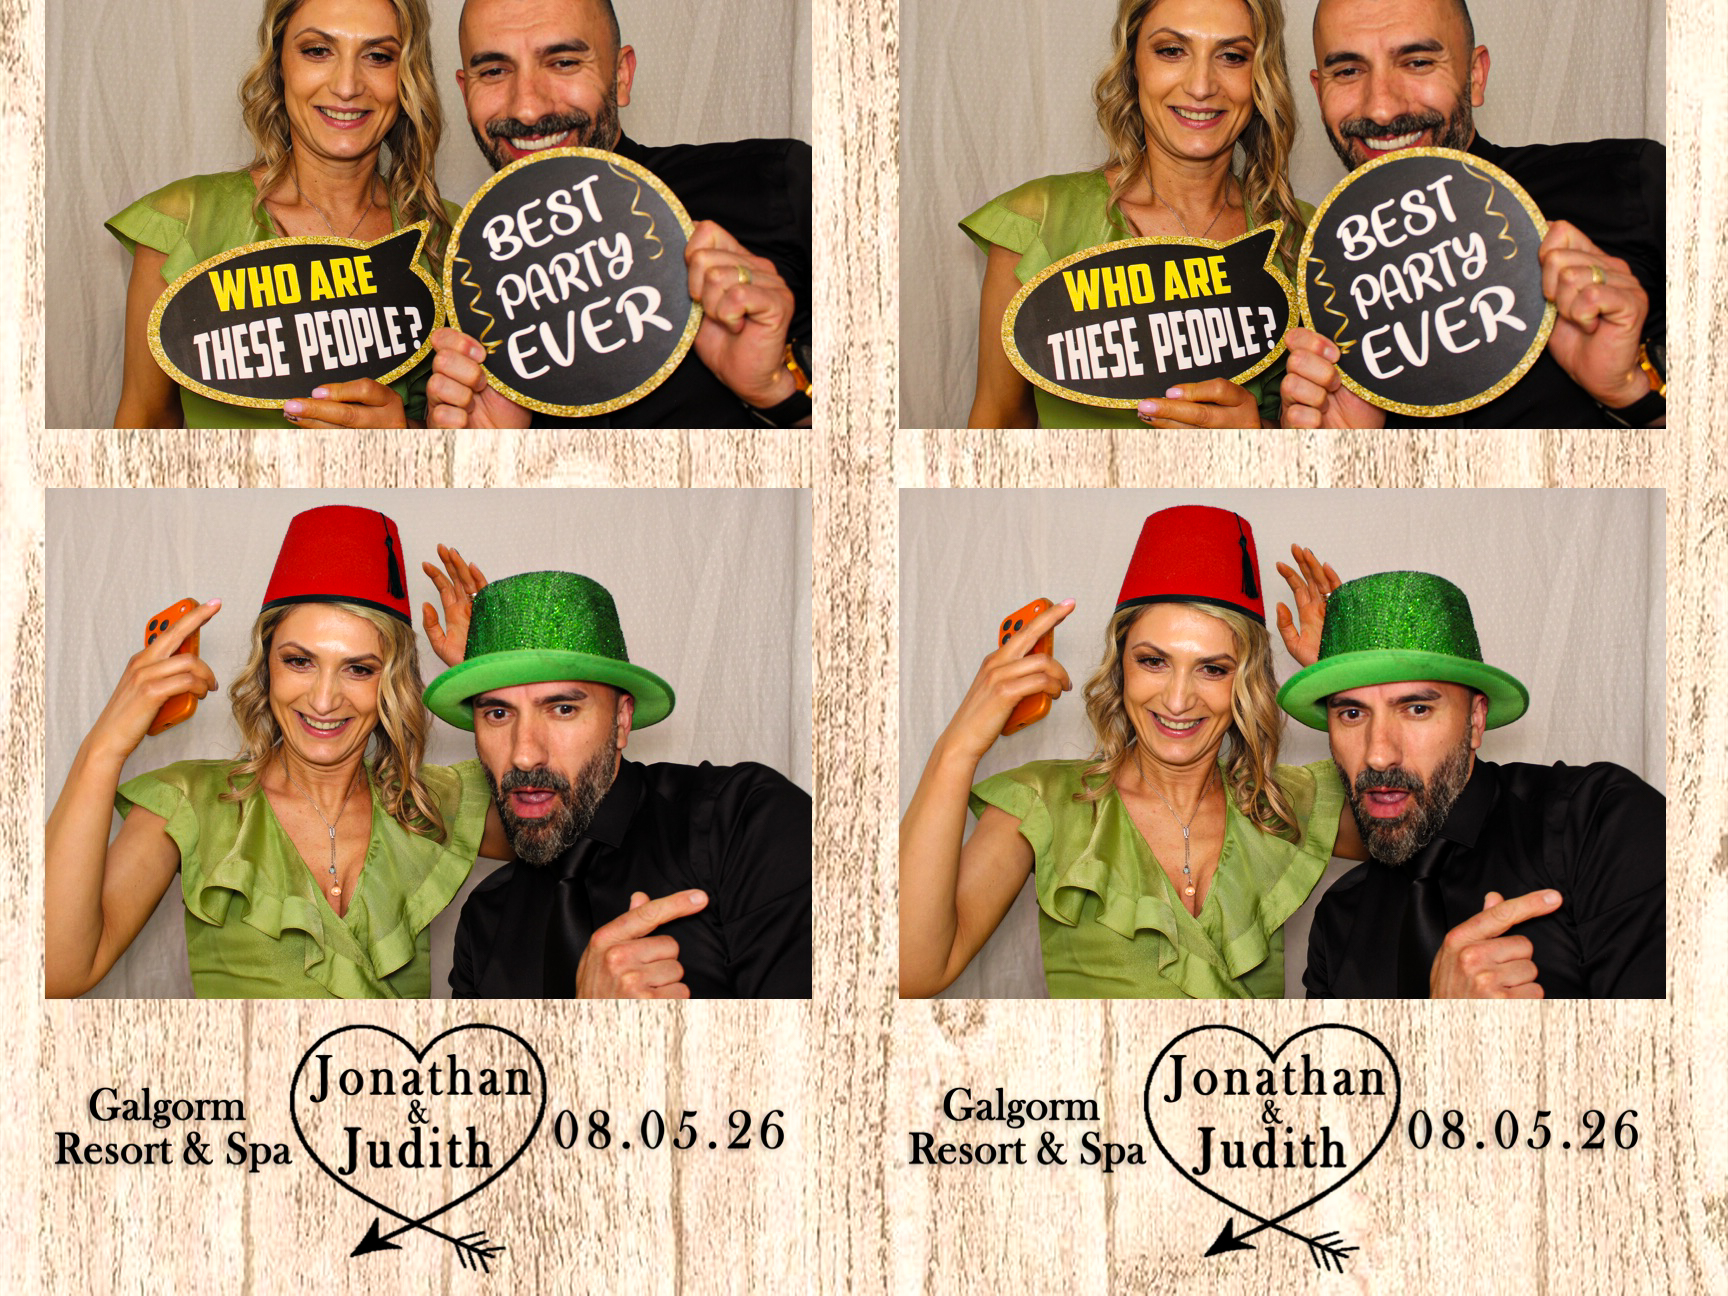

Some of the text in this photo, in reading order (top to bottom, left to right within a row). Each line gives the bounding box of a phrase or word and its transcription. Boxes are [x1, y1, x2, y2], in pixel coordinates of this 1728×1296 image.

[483, 175, 602, 260] BEST
[1337, 175, 1456, 260] BEST
[209, 255, 377, 311] WHO ARE
[496, 232, 633, 319] PARTY
[1063, 255, 1231, 311] WHO ARE
[1350, 232, 1487, 319] PARTY
[193, 306, 423, 381] THESE PEOPLE?
[508, 286, 673, 380] EVER
[1047, 306, 1277, 381] THESE PEOPLE?
[1362, 286, 1527, 380] EVER
